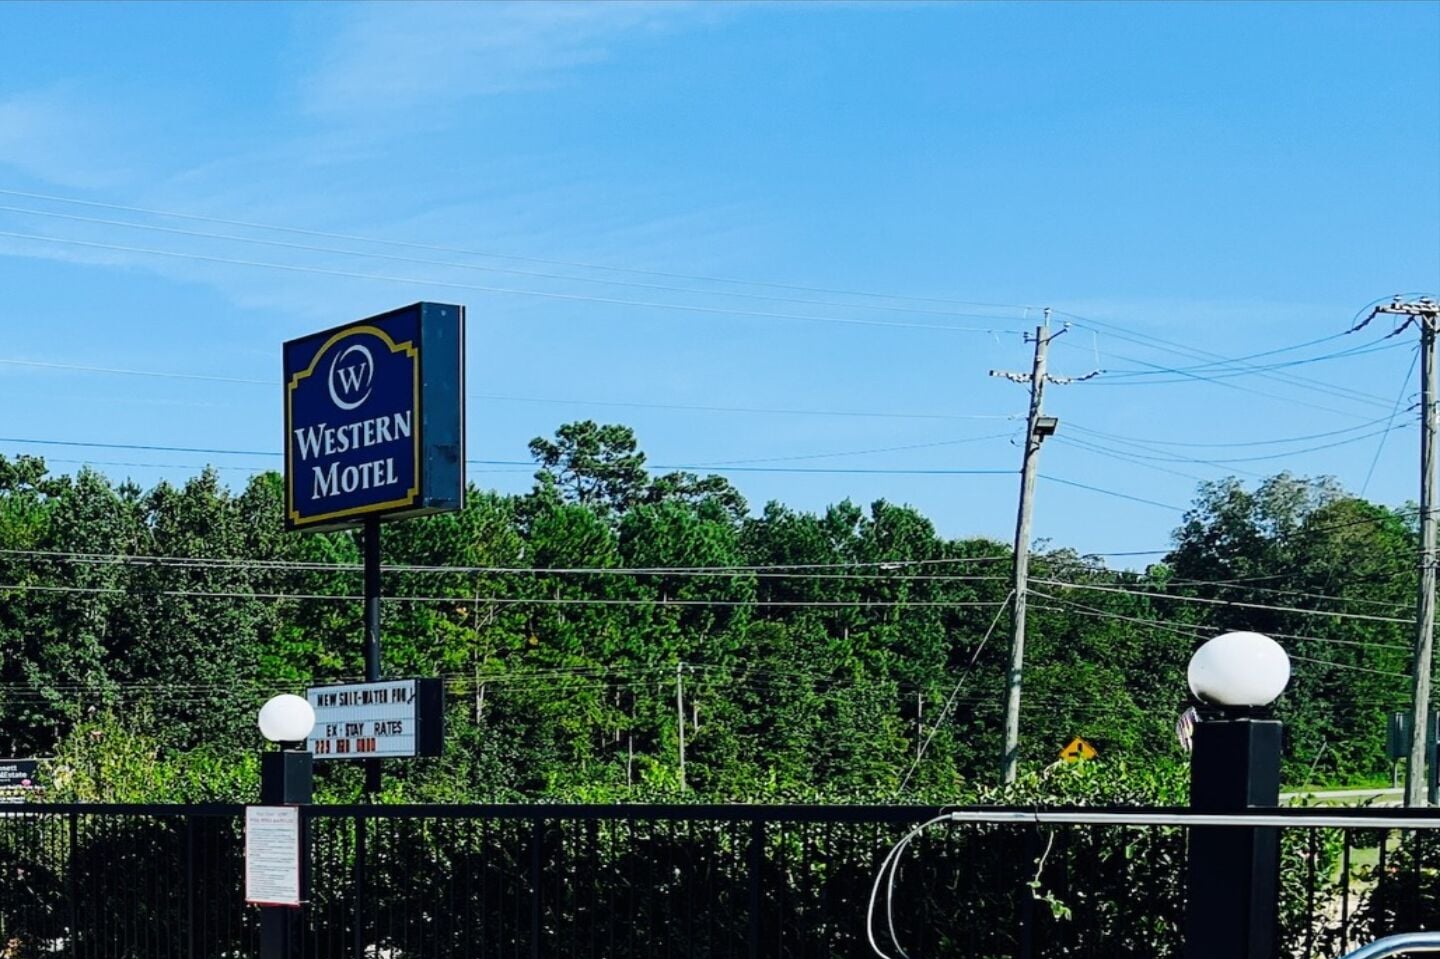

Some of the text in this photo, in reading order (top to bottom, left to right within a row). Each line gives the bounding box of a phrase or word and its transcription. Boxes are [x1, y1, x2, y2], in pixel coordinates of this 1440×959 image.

[337, 362, 367, 394] W
[294, 410, 412, 461] WESTERN
[311, 457, 398, 500] MOTEL
[317, 693, 337, 707] NEW
[374, 721, 403, 736] RATES
